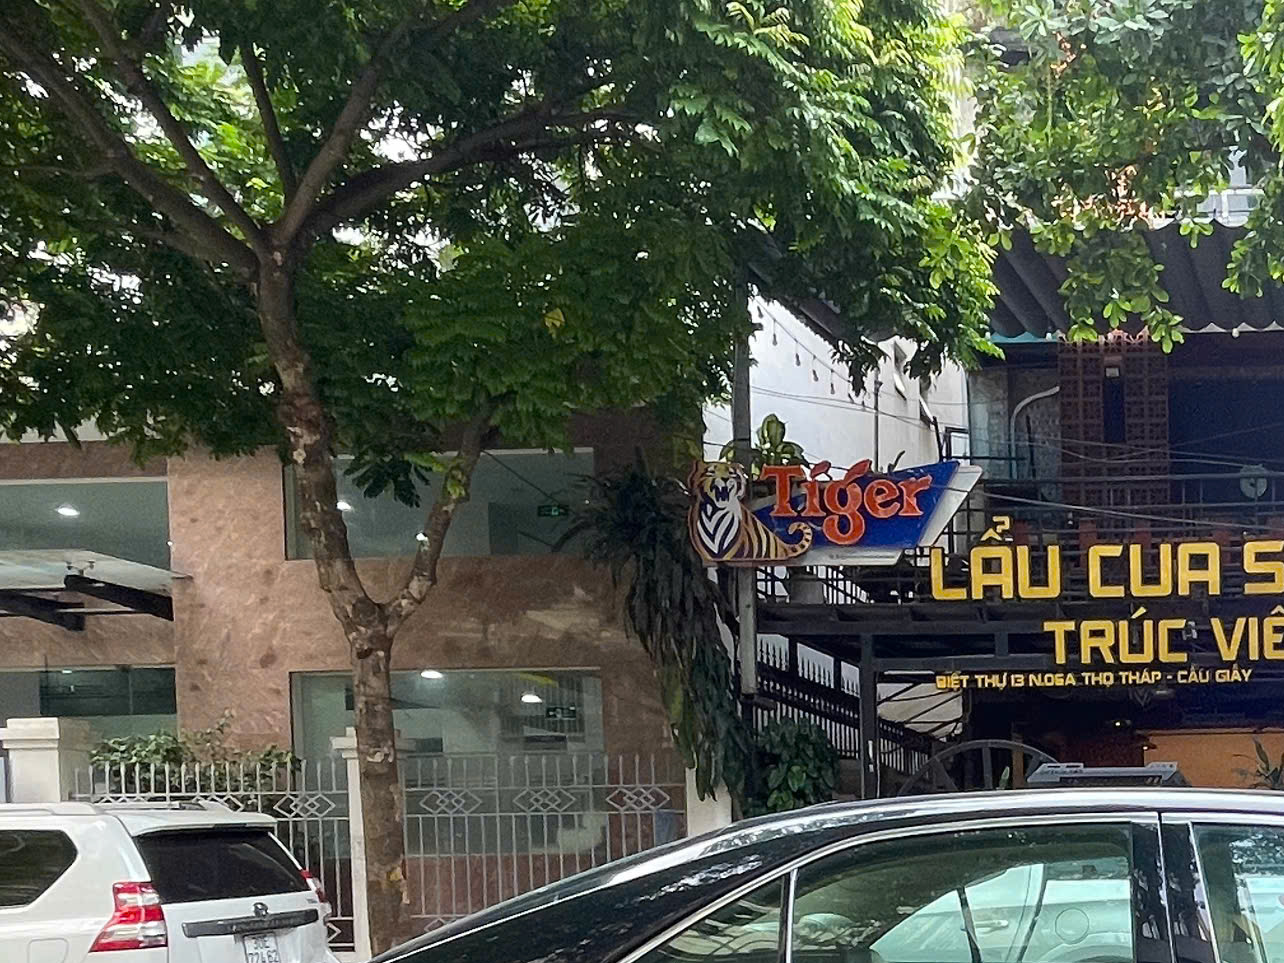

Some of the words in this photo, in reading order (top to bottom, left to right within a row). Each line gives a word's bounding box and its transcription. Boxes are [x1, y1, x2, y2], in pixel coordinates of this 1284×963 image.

[761, 459, 932, 545] Tiger
[930, 516, 1060, 600] LẨU
[1089, 541, 1221, 598] CUA
[1043, 608, 1187, 665] TRÚC
[1119, 668, 1162, 686] THÁP
